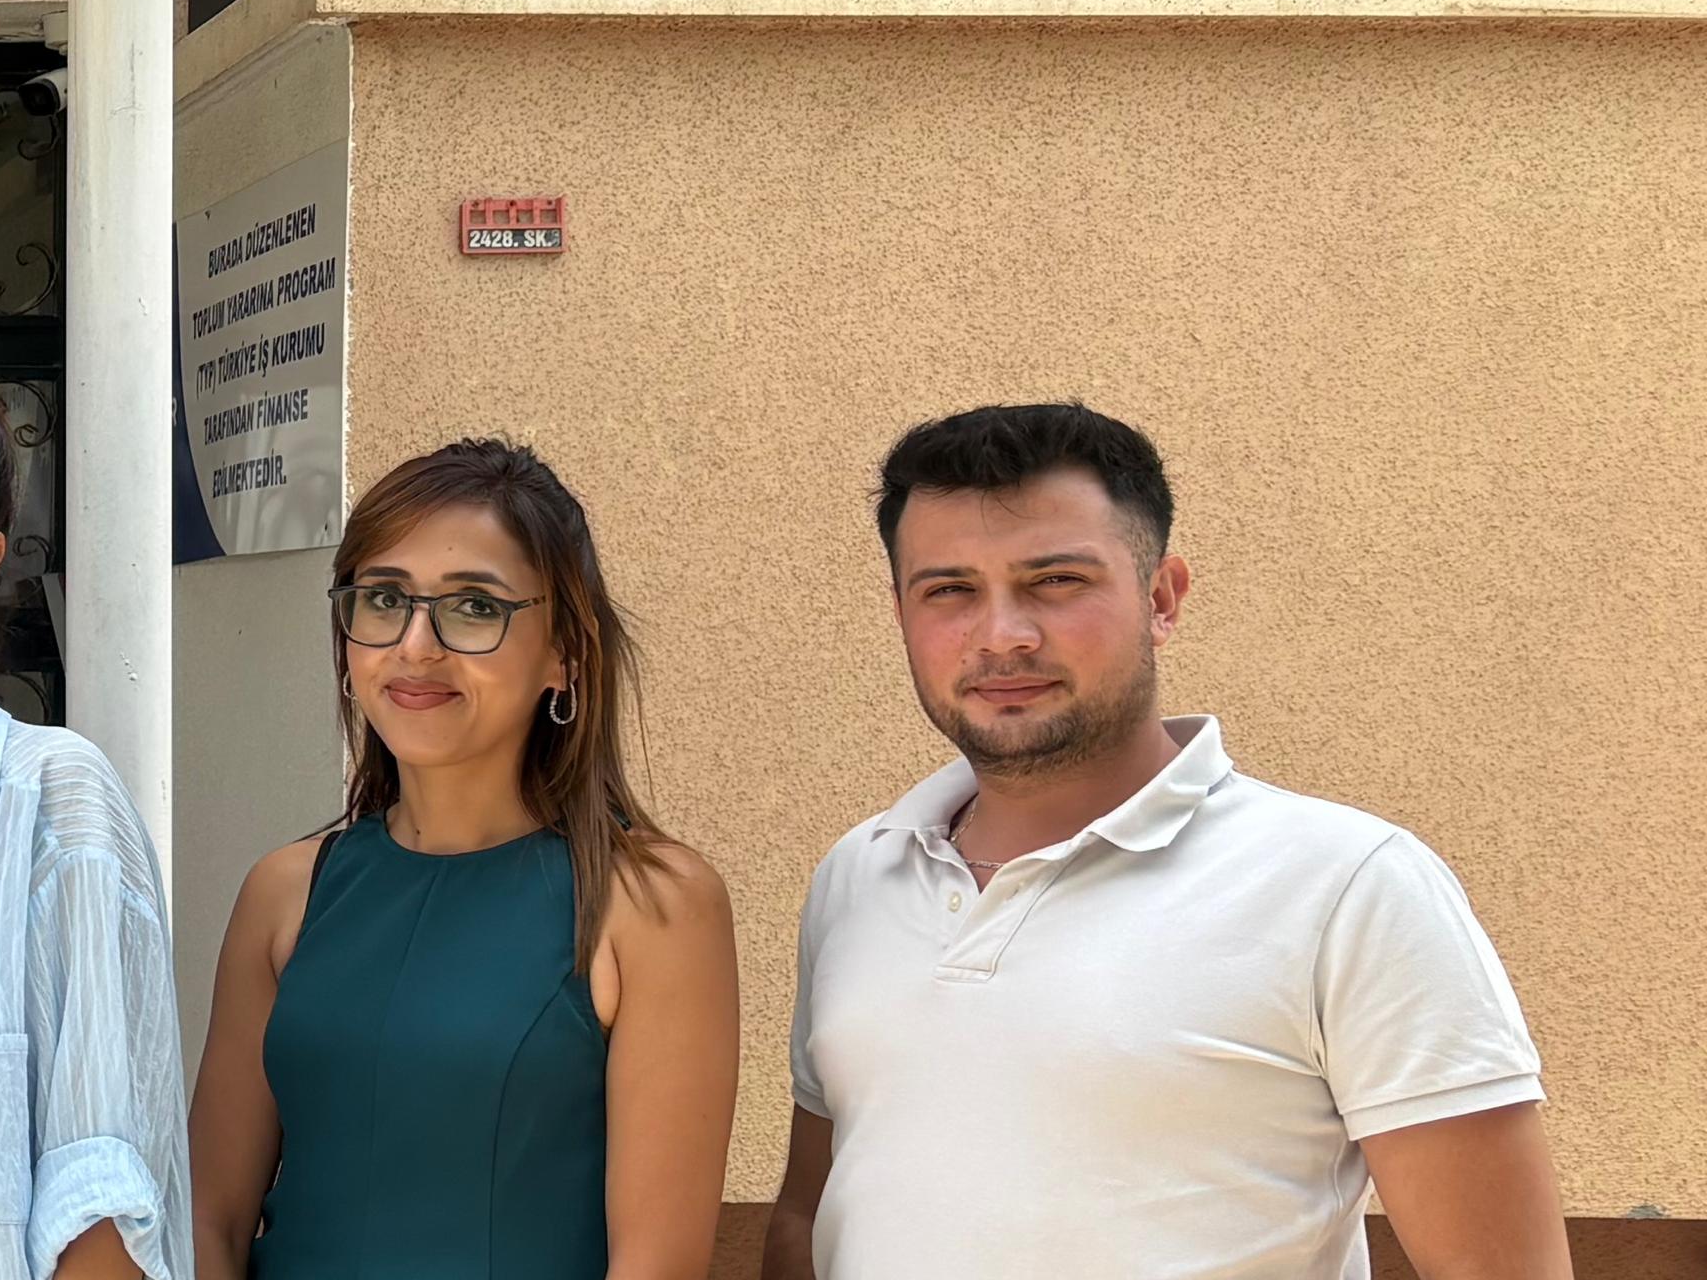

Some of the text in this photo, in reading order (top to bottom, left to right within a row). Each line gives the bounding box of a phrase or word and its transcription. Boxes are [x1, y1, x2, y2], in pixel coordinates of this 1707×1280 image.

[208, 202, 316, 279] BURADA DÜZENLENEN
[469, 229, 519, 248] 2428.
[193, 256, 336, 340] TOPLUM YARARINA PROGRAM
[218, 340, 257, 385] TÜRKİYE
[258, 333, 269, 377] İŞ
[271, 322, 325, 367] KURUMU
[204, 402, 255, 446] TARAFINDAN
[256, 388, 309, 430] FİNANSE
[212, 447, 287, 499] EDİLMEKTEDİR.
